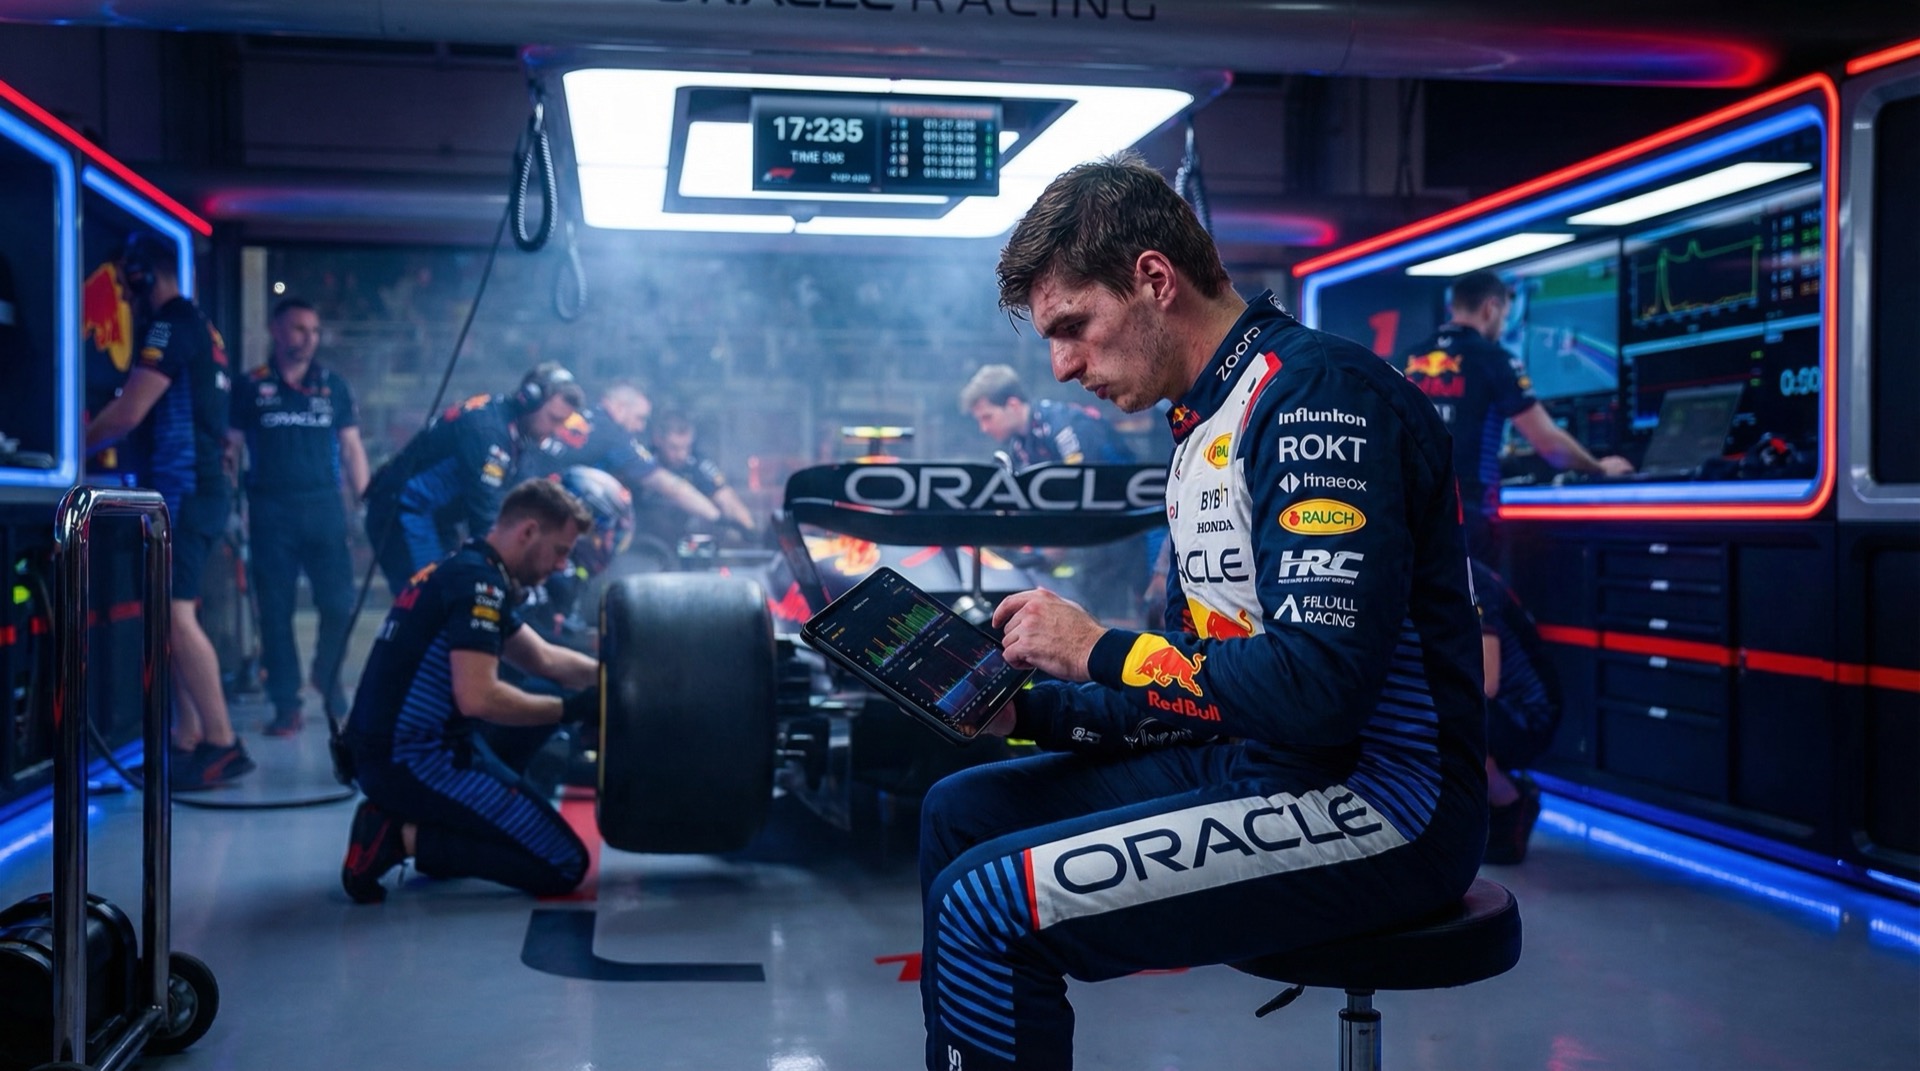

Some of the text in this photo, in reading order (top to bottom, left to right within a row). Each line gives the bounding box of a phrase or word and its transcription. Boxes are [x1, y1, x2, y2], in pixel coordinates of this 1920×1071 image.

[773, 116, 864, 143] 17:235
[1279, 434, 1367, 463] ROKT
[844, 467, 1166, 510] ORACLE
[1197, 519, 1235, 534] HONDA
[1302, 511, 1354, 526] RAUCH
[1279, 549, 1364, 579] HRC
[1304, 611, 1355, 628] RACING
[1054, 792, 1383, 894] ORACLE
